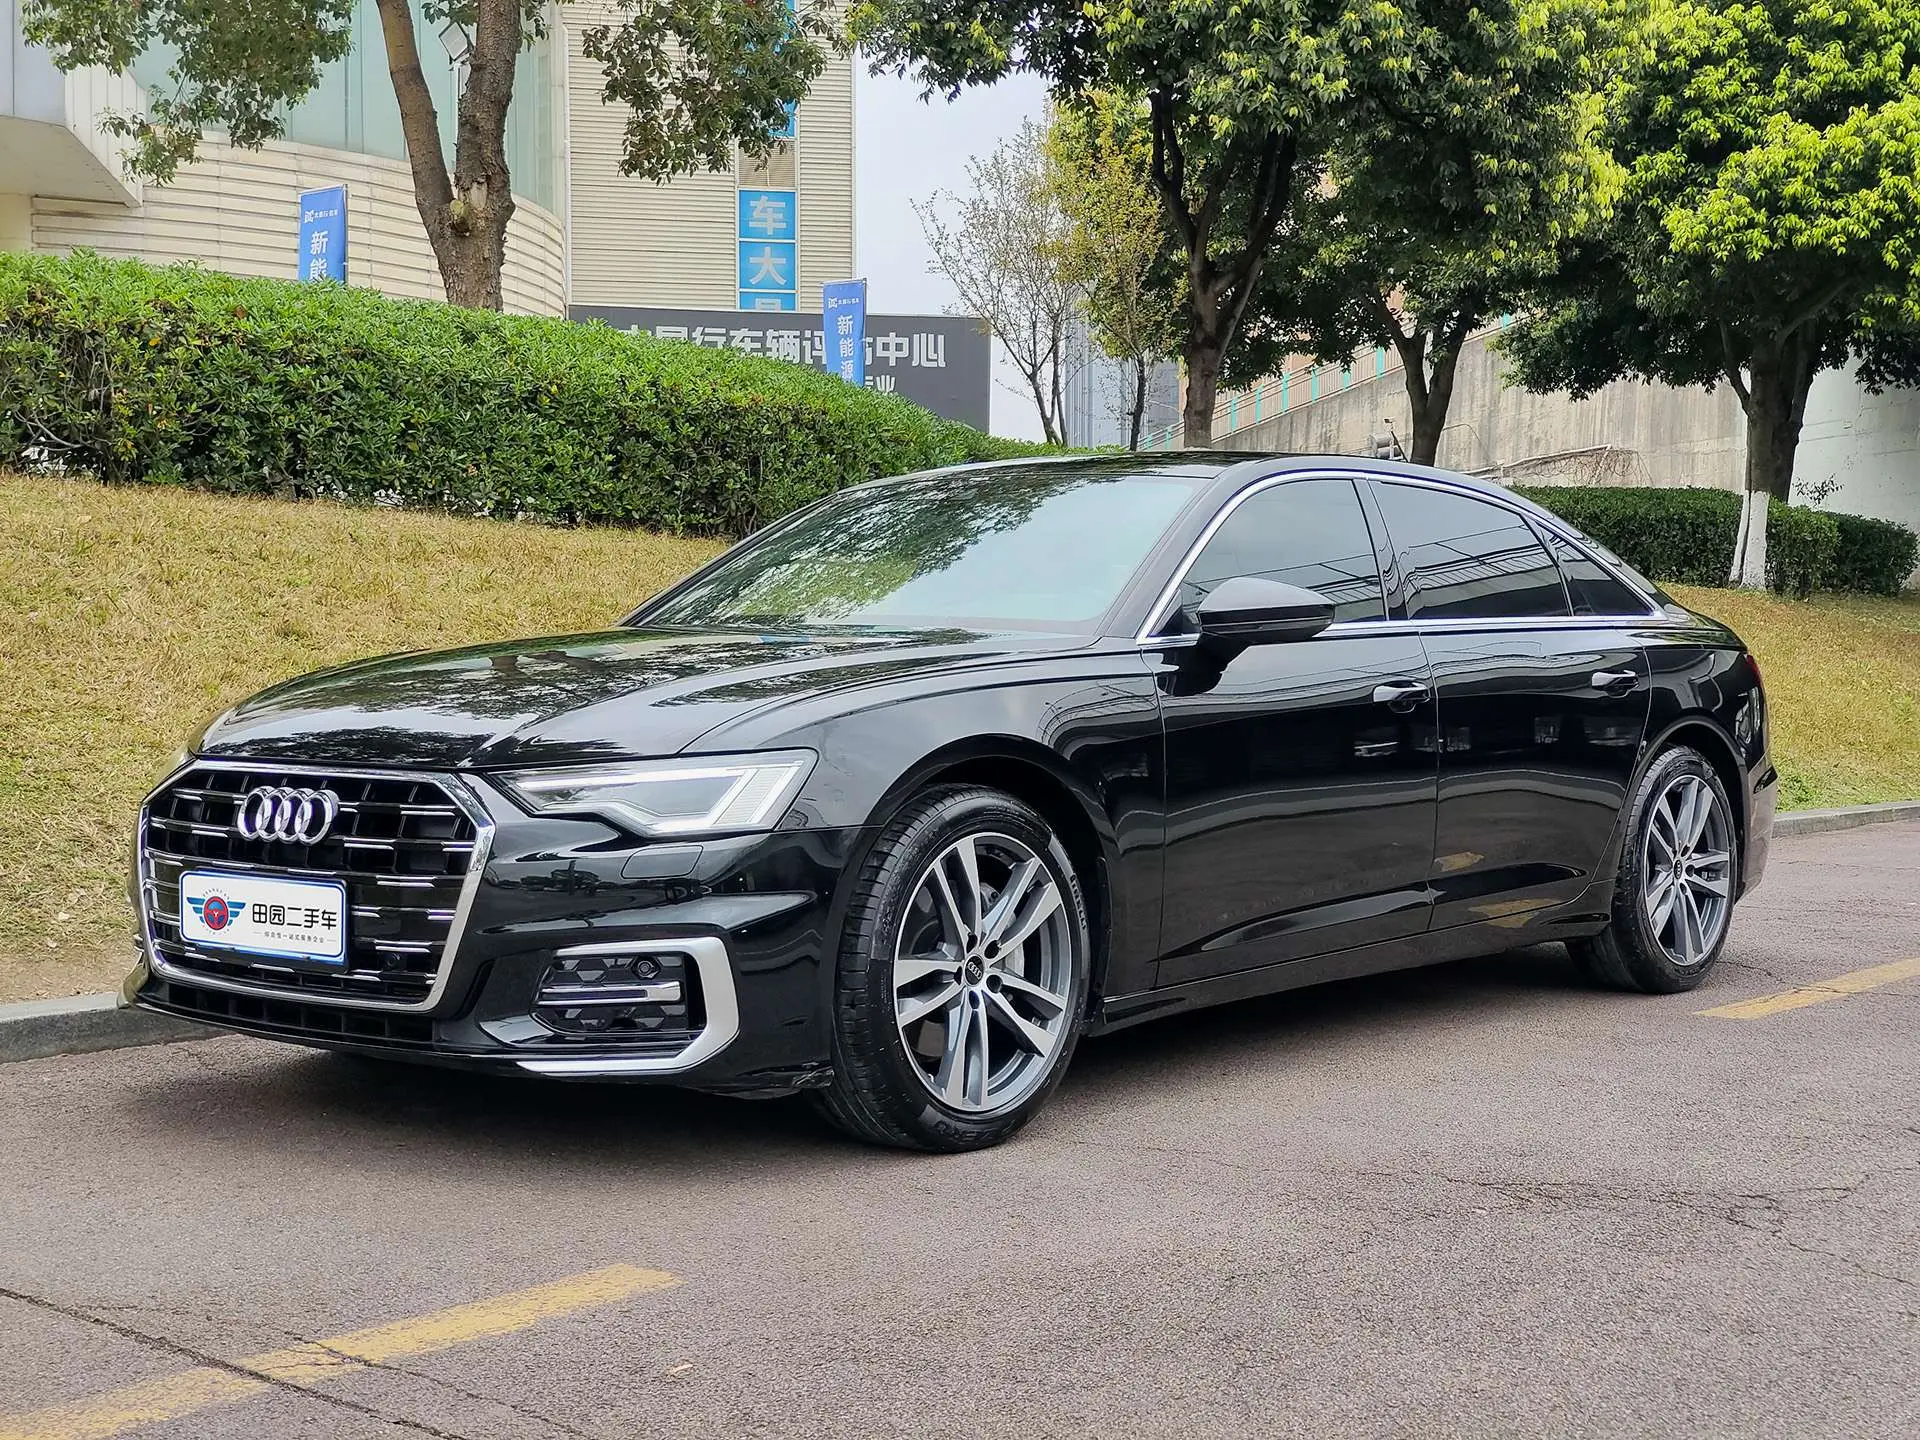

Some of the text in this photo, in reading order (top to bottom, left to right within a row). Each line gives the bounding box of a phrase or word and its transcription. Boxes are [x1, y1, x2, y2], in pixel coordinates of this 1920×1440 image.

[310, 231, 328, 281] 新能
[618, 325, 946, 367] 行车辆评中心
[837, 314, 854, 381] 新能源
[252, 903, 337, 930] 田园二手车
